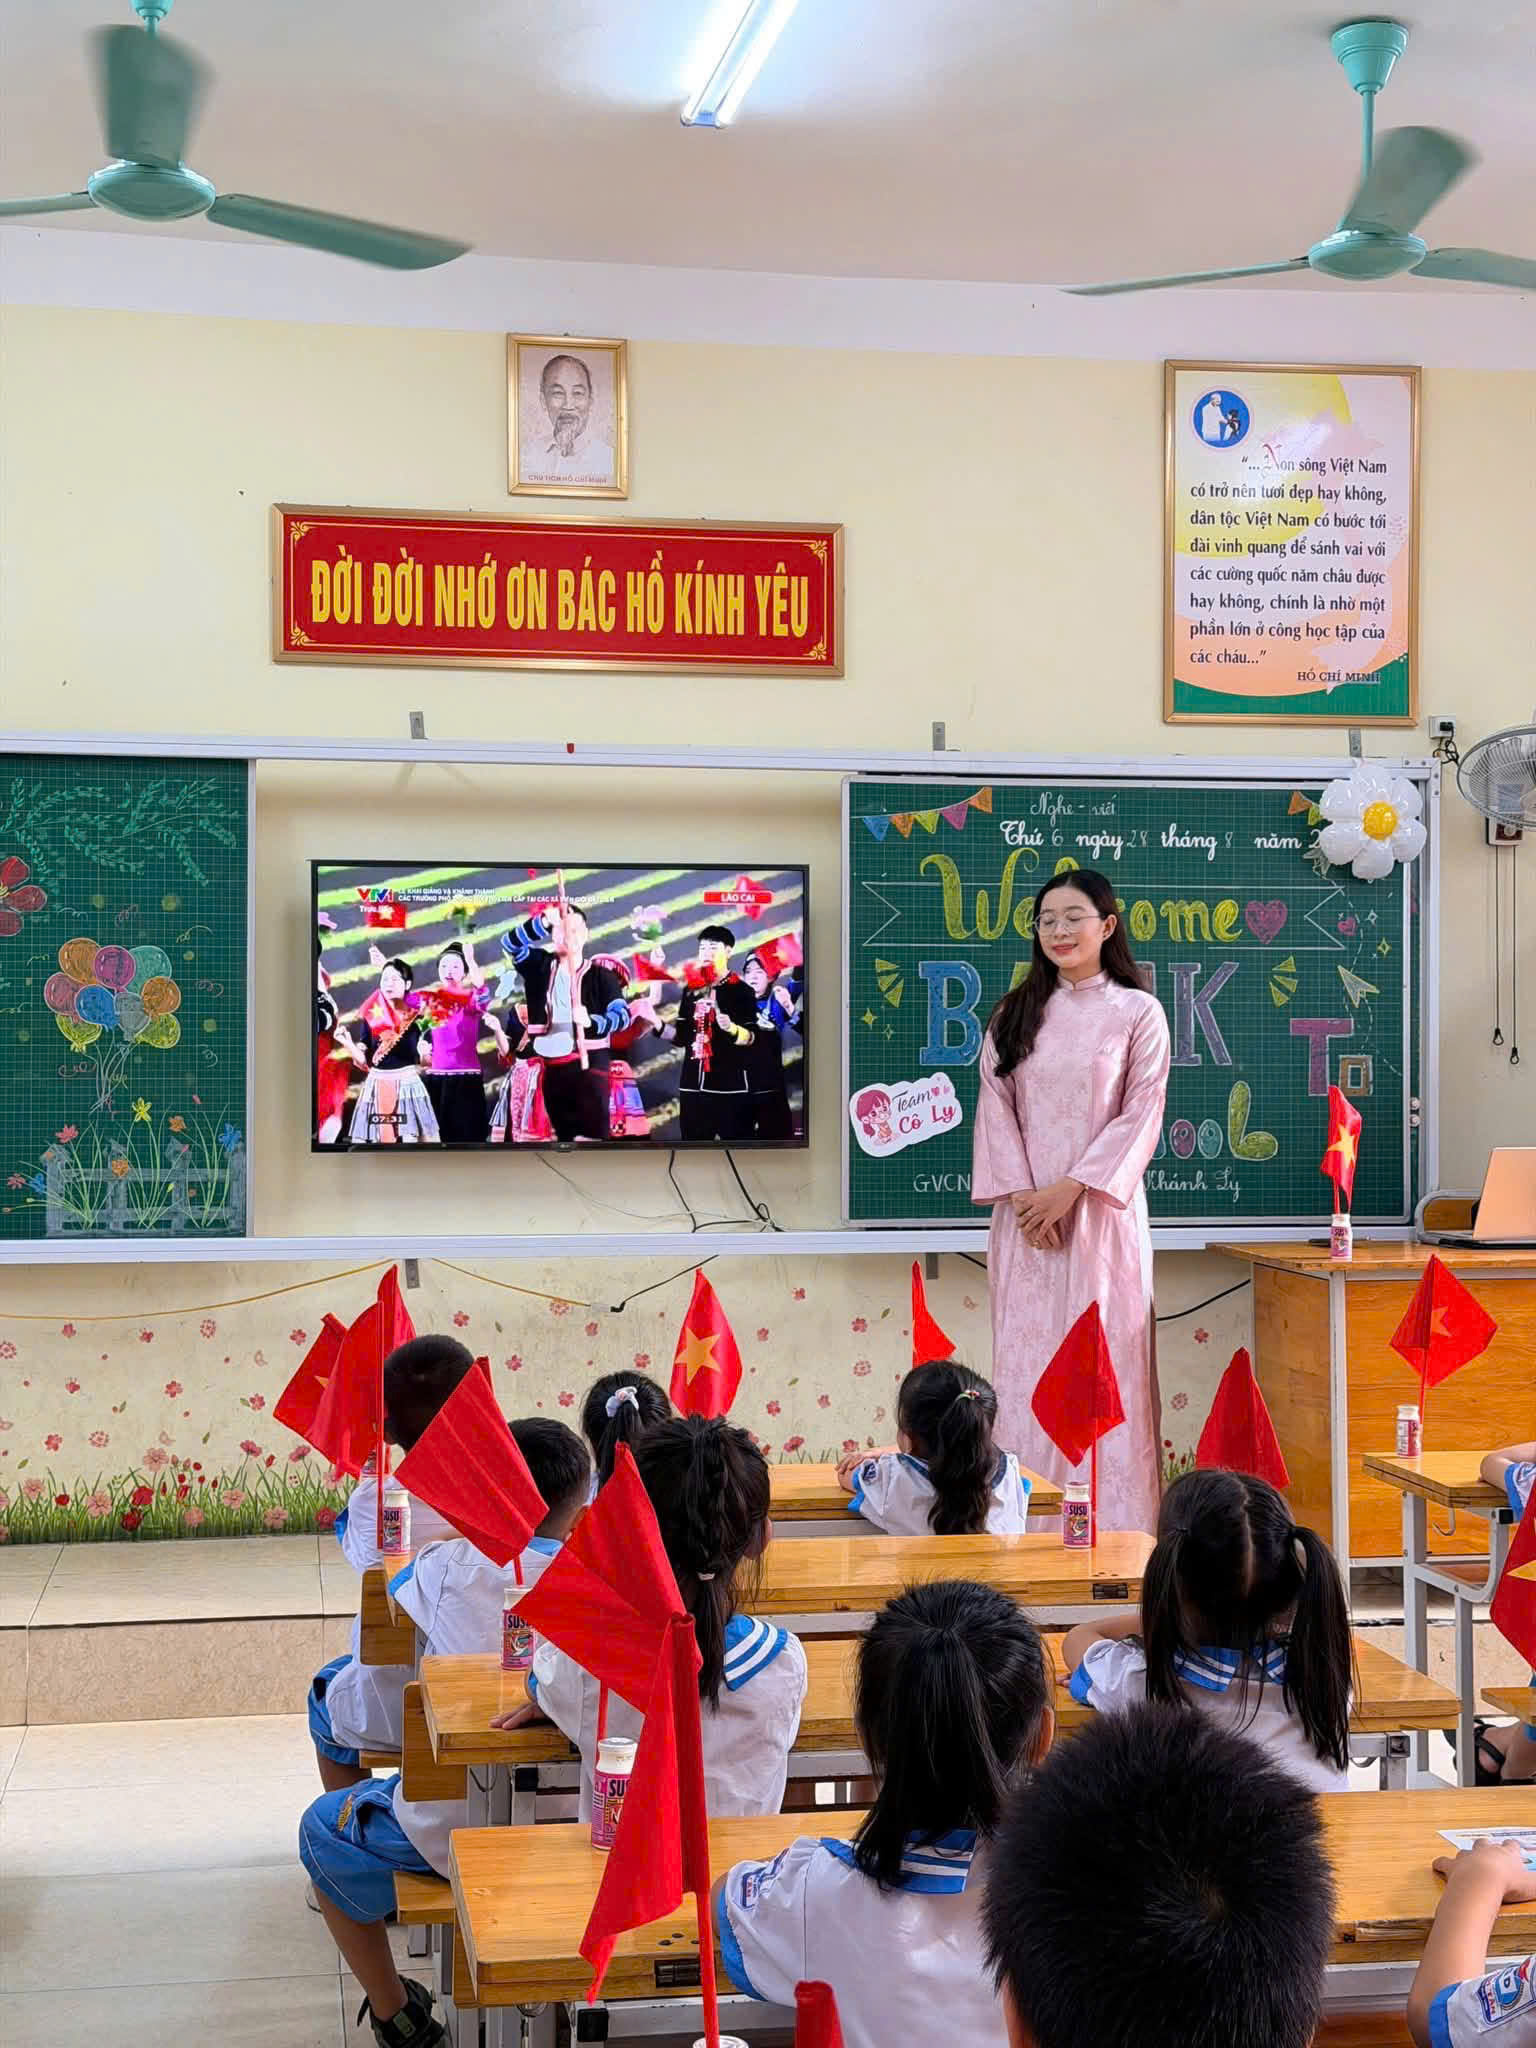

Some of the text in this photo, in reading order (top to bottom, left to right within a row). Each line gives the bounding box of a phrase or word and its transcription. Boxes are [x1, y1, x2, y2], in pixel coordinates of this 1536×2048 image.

[1299, 457, 1326, 476] sông
[1330, 457, 1354, 477] Việt
[1358, 459, 1387, 474] Nam
[1190, 481, 1387, 506] có trở nên tươi đẹp hay không,
[1190, 511, 1386, 530] dân tộc Việt Nam có bước tới
[1190, 536, 1386, 558] đài vinh quang để sánh vai với
[1190, 564, 1386, 588] các cường quốc năm châu được
[311, 545, 809, 638] ĐỜI ĐỜI NHỚ ƠN BÁC HỒ KÍNH YÊU
[1190, 592, 1385, 614] hay không, chính là nhờ một
[1190, 618, 1385, 642] phần lớn ở công học tập của
[1190, 649, 1212, 664] các
[1345, 671, 1381, 682] MINH
[1030, 791, 1074, 827] Nghe
[1000, 820, 1044, 846] Thứ
[1051, 829, 1064, 847] 6
[1075, 830, 1124, 860] ngày
[1161, 823, 1218, 861] tháng
[1254, 833, 1303, 849] năm
[892, 1090, 932, 1113] Team
[899, 1105, 956, 1134] Cô Ly
[912, 1173, 971, 1193] GVCN
[1069, 1504, 1088, 1516] SUSU
